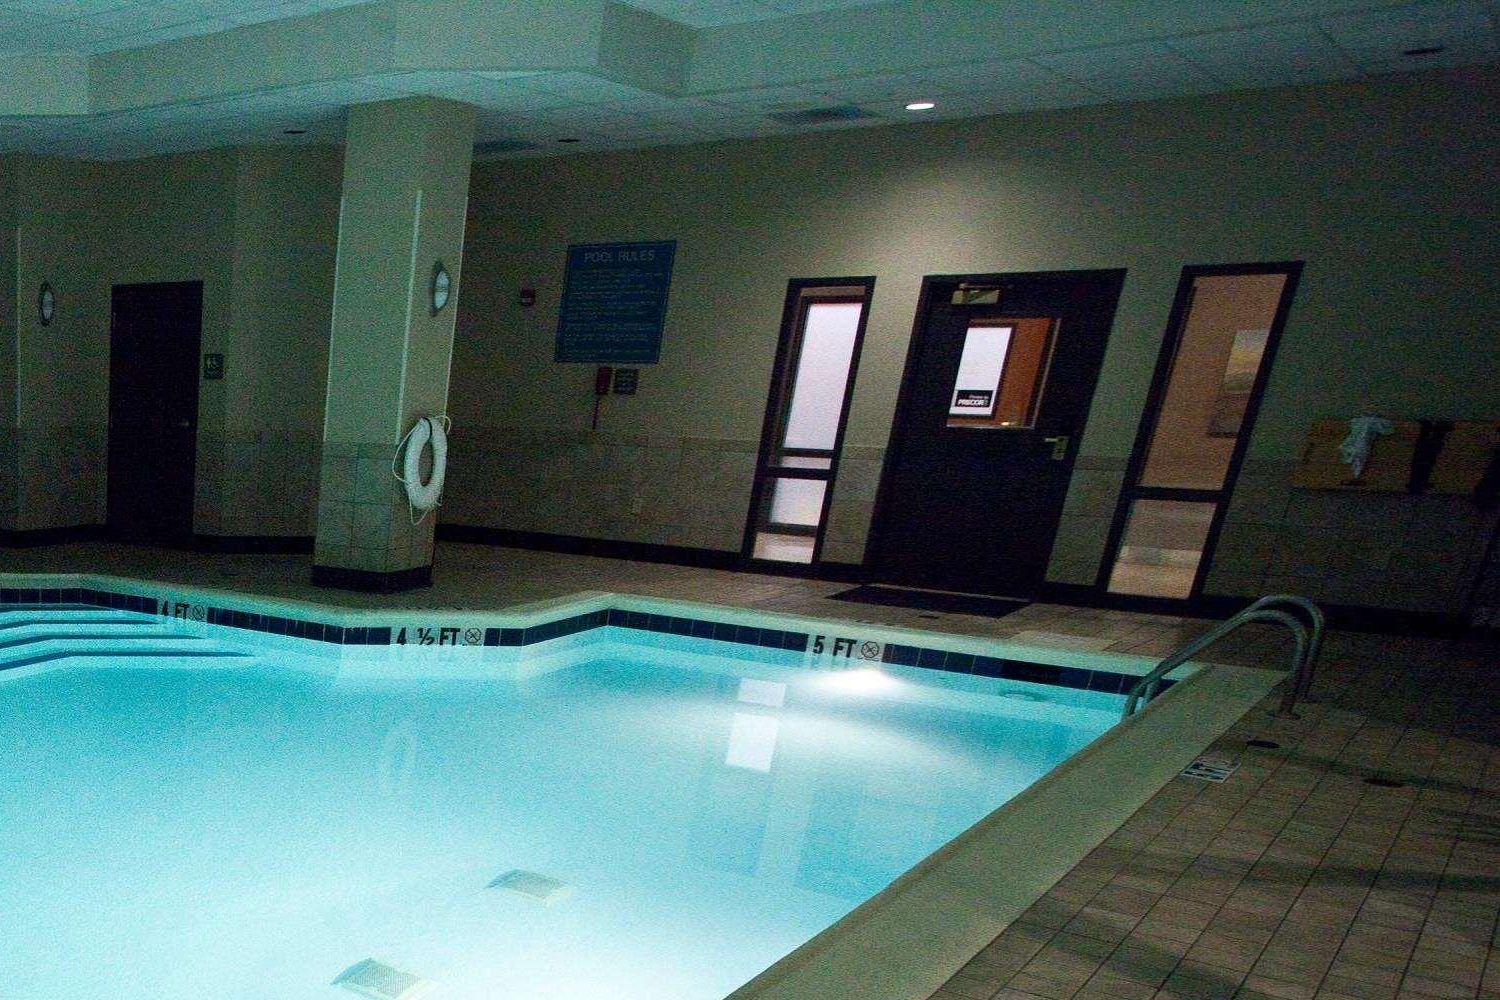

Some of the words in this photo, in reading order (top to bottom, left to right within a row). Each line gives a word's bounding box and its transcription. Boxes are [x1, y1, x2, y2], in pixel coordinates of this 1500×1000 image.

[584, 250, 613, 263] POOL
[618, 249, 655, 262] RULES
[175, 602, 190, 619] FT
[396, 627, 406, 645] 4
[439, 626, 461, 646] FT
[813, 635, 826, 654] 5
[833, 638, 857, 658] FT
